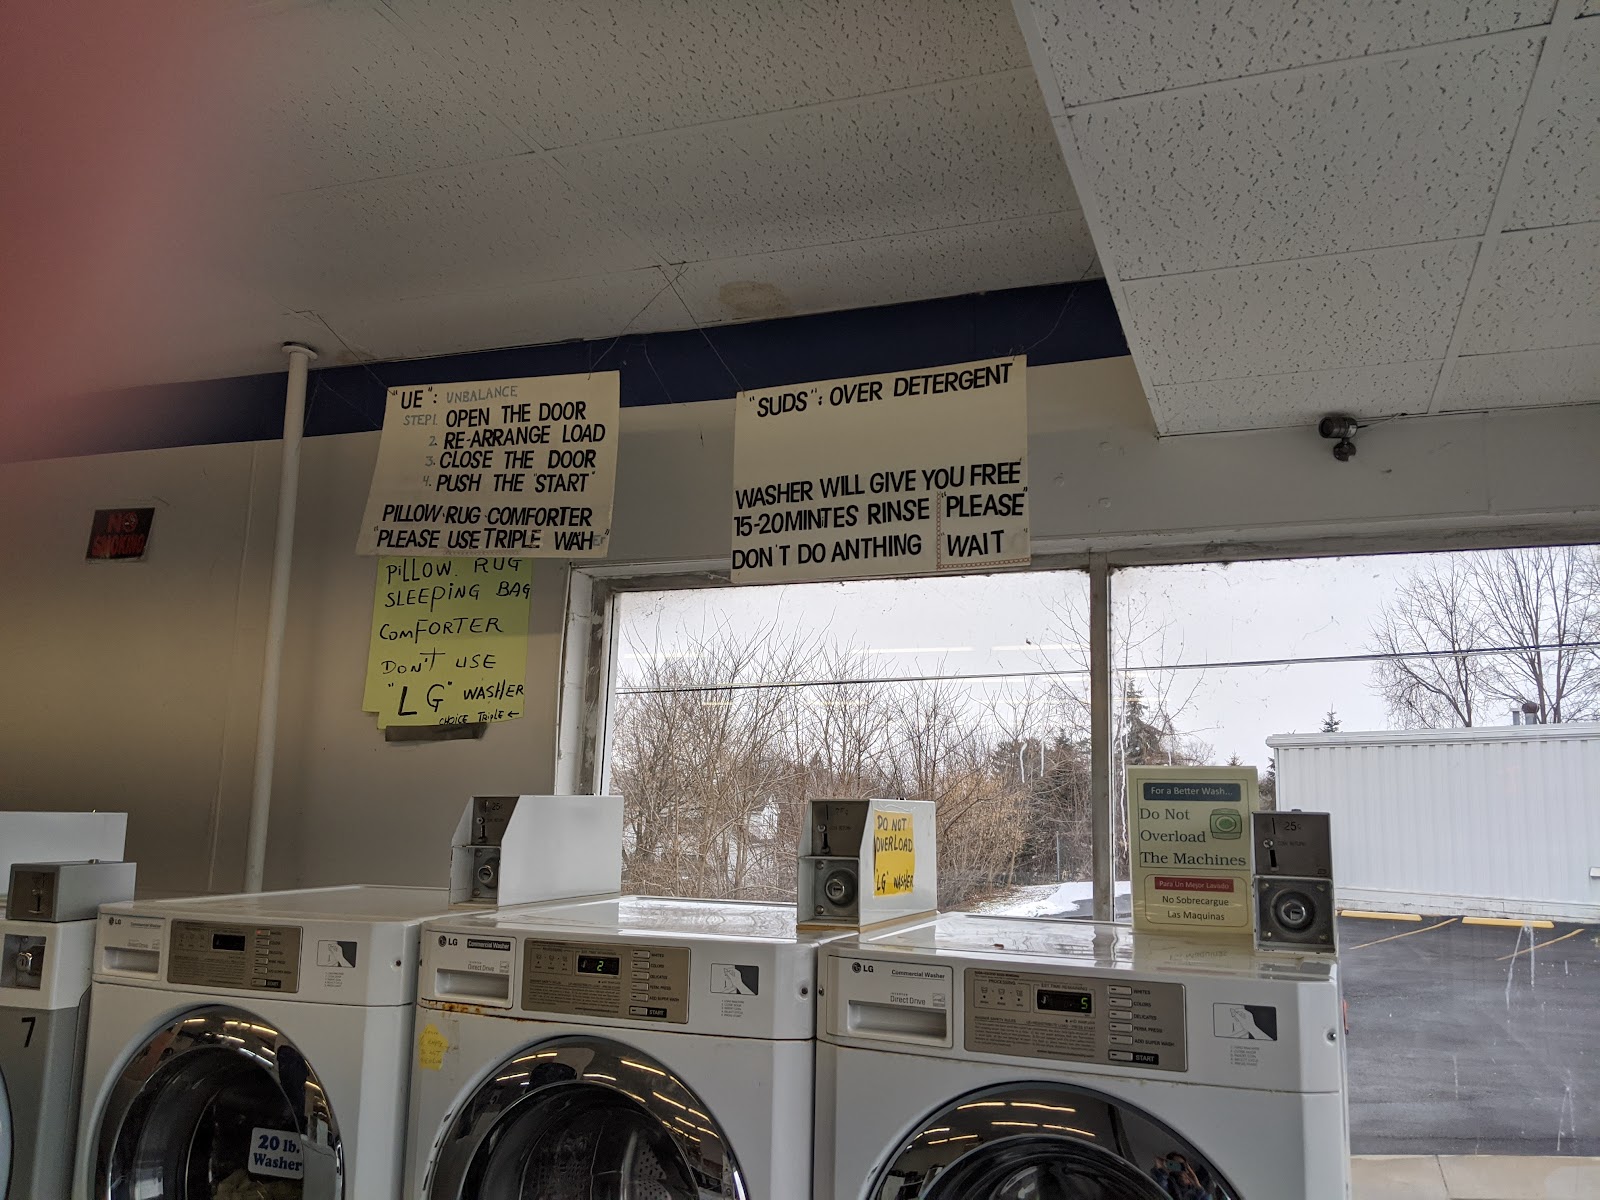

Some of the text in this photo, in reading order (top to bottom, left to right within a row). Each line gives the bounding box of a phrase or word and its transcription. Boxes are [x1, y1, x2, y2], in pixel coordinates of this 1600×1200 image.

[829, 381, 883, 407] OVER
[893, 362, 1013, 398] DETERGENT
[446, 385, 518, 404] UNBALANCE
[446, 407, 490, 428] OPEN
[501, 403, 531, 425] THE
[538, 401, 586, 421] DOOR
[444, 425, 551, 450] RE-ARRANGE
[562, 423, 606, 443] LOAD
[439, 450, 494, 469] CLOSE
[504, 450, 534, 469] THE
[547, 449, 597, 469] DOOR
[436, 473, 482, 493] PUSH
[493, 473, 526, 492] THE
[735, 480, 813, 510] WASHER
[820, 473, 866, 499] WILL
[870, 469, 917, 493] GIVE
[921, 465, 965, 491] YOU
[867, 498, 930, 525] RINSE
[447, 530, 482, 549] USE
[483, 527, 542, 549] TRIPLE
[731, 544, 791, 570] DON'T
[797, 543, 826, 565] DO
[831, 534, 922, 563] ANTHING
[474, 557, 522, 573] RUG
[496, 581, 531, 600] BAG
[455, 653, 497, 669] USE
[463, 678, 524, 700] WASHER
[1151, 786, 1165, 795] For
[1173, 786, 1199, 795] Better
[877, 815, 907, 831] DO NOT
[1139, 808, 1190, 821] Do Not
[876, 834, 914, 853] OVERLOAD
[1140, 829, 1206, 843] Overload
[1140, 852, 1247, 866] The Machines
[893, 869, 914, 891] WASHER
[1185, 882, 1205, 890] Mejor
[1206, 882, 1230, 890] Lavado
[1162, 895, 1230, 907] No Sobrecargue
[1167, 910, 1225, 922] Las Maquinas
[891, 969, 924, 978] Commercial
[890, 995, 926, 1006] Direct Drive
[22, 1017, 36, 1048] 7
[1135, 1054, 1155, 1062] START
[258, 1134, 300, 1153] 20 lb.
[253, 1152, 302, 1171] Washer
